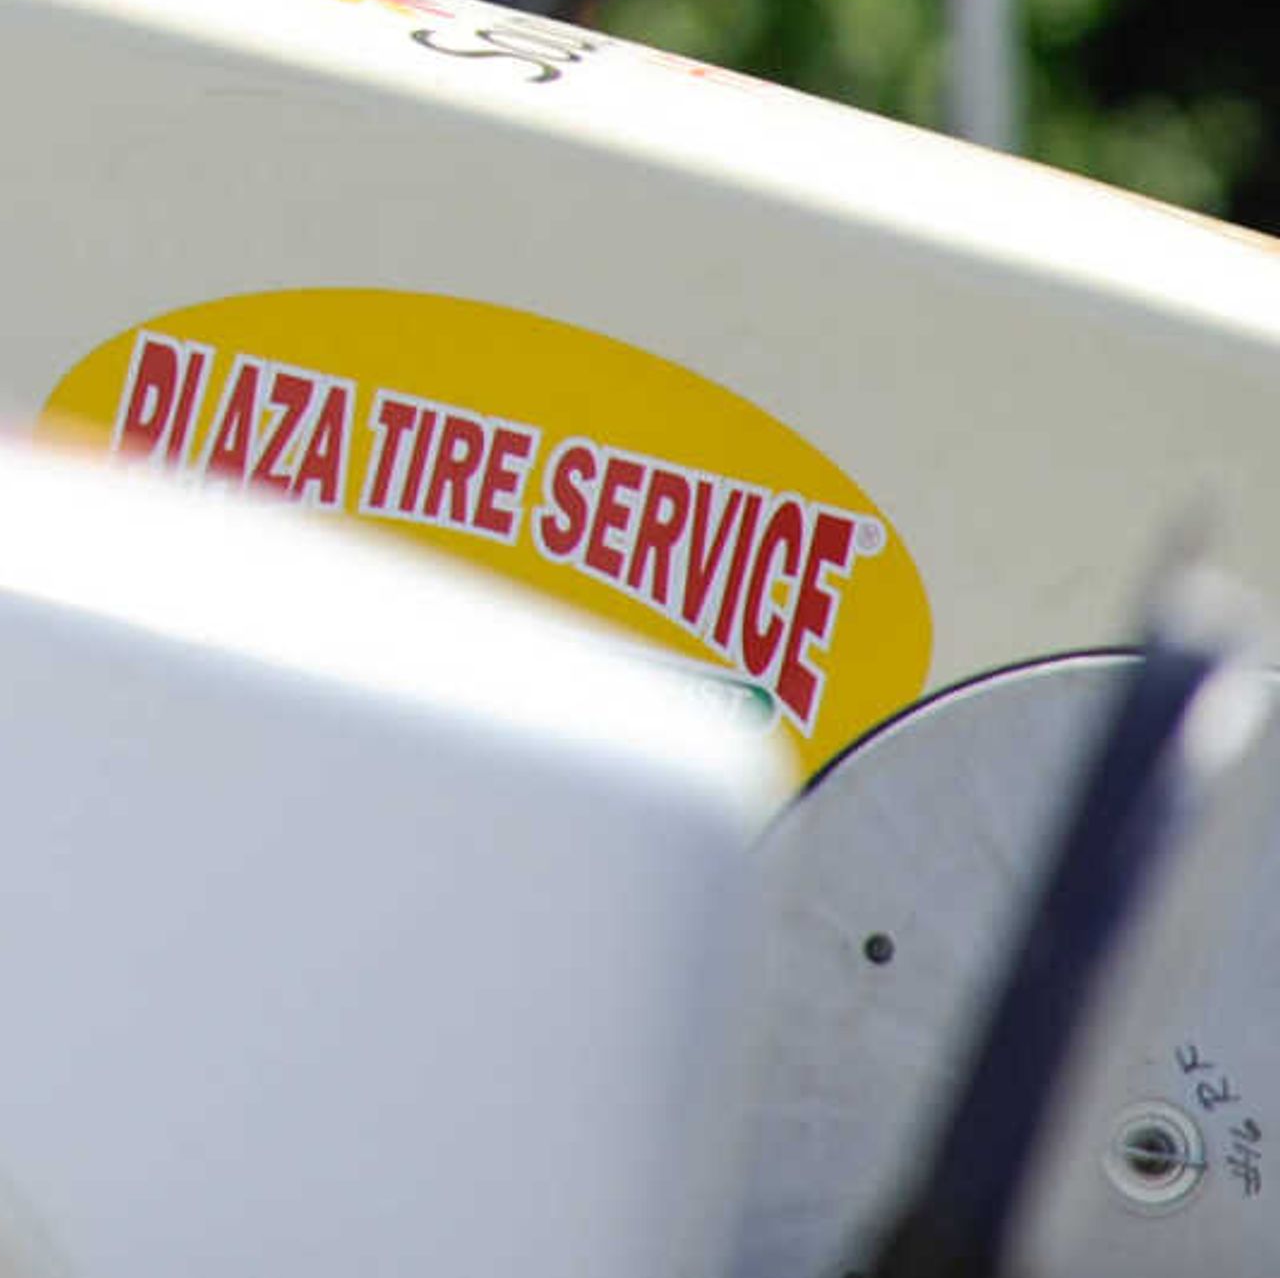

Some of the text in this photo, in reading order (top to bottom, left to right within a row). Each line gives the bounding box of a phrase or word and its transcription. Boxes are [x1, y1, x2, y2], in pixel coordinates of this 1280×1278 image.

[114, 336, 352, 508] PLAZA
[366, 395, 536, 540] TIRE
[538, 440, 858, 730] SERVICE
